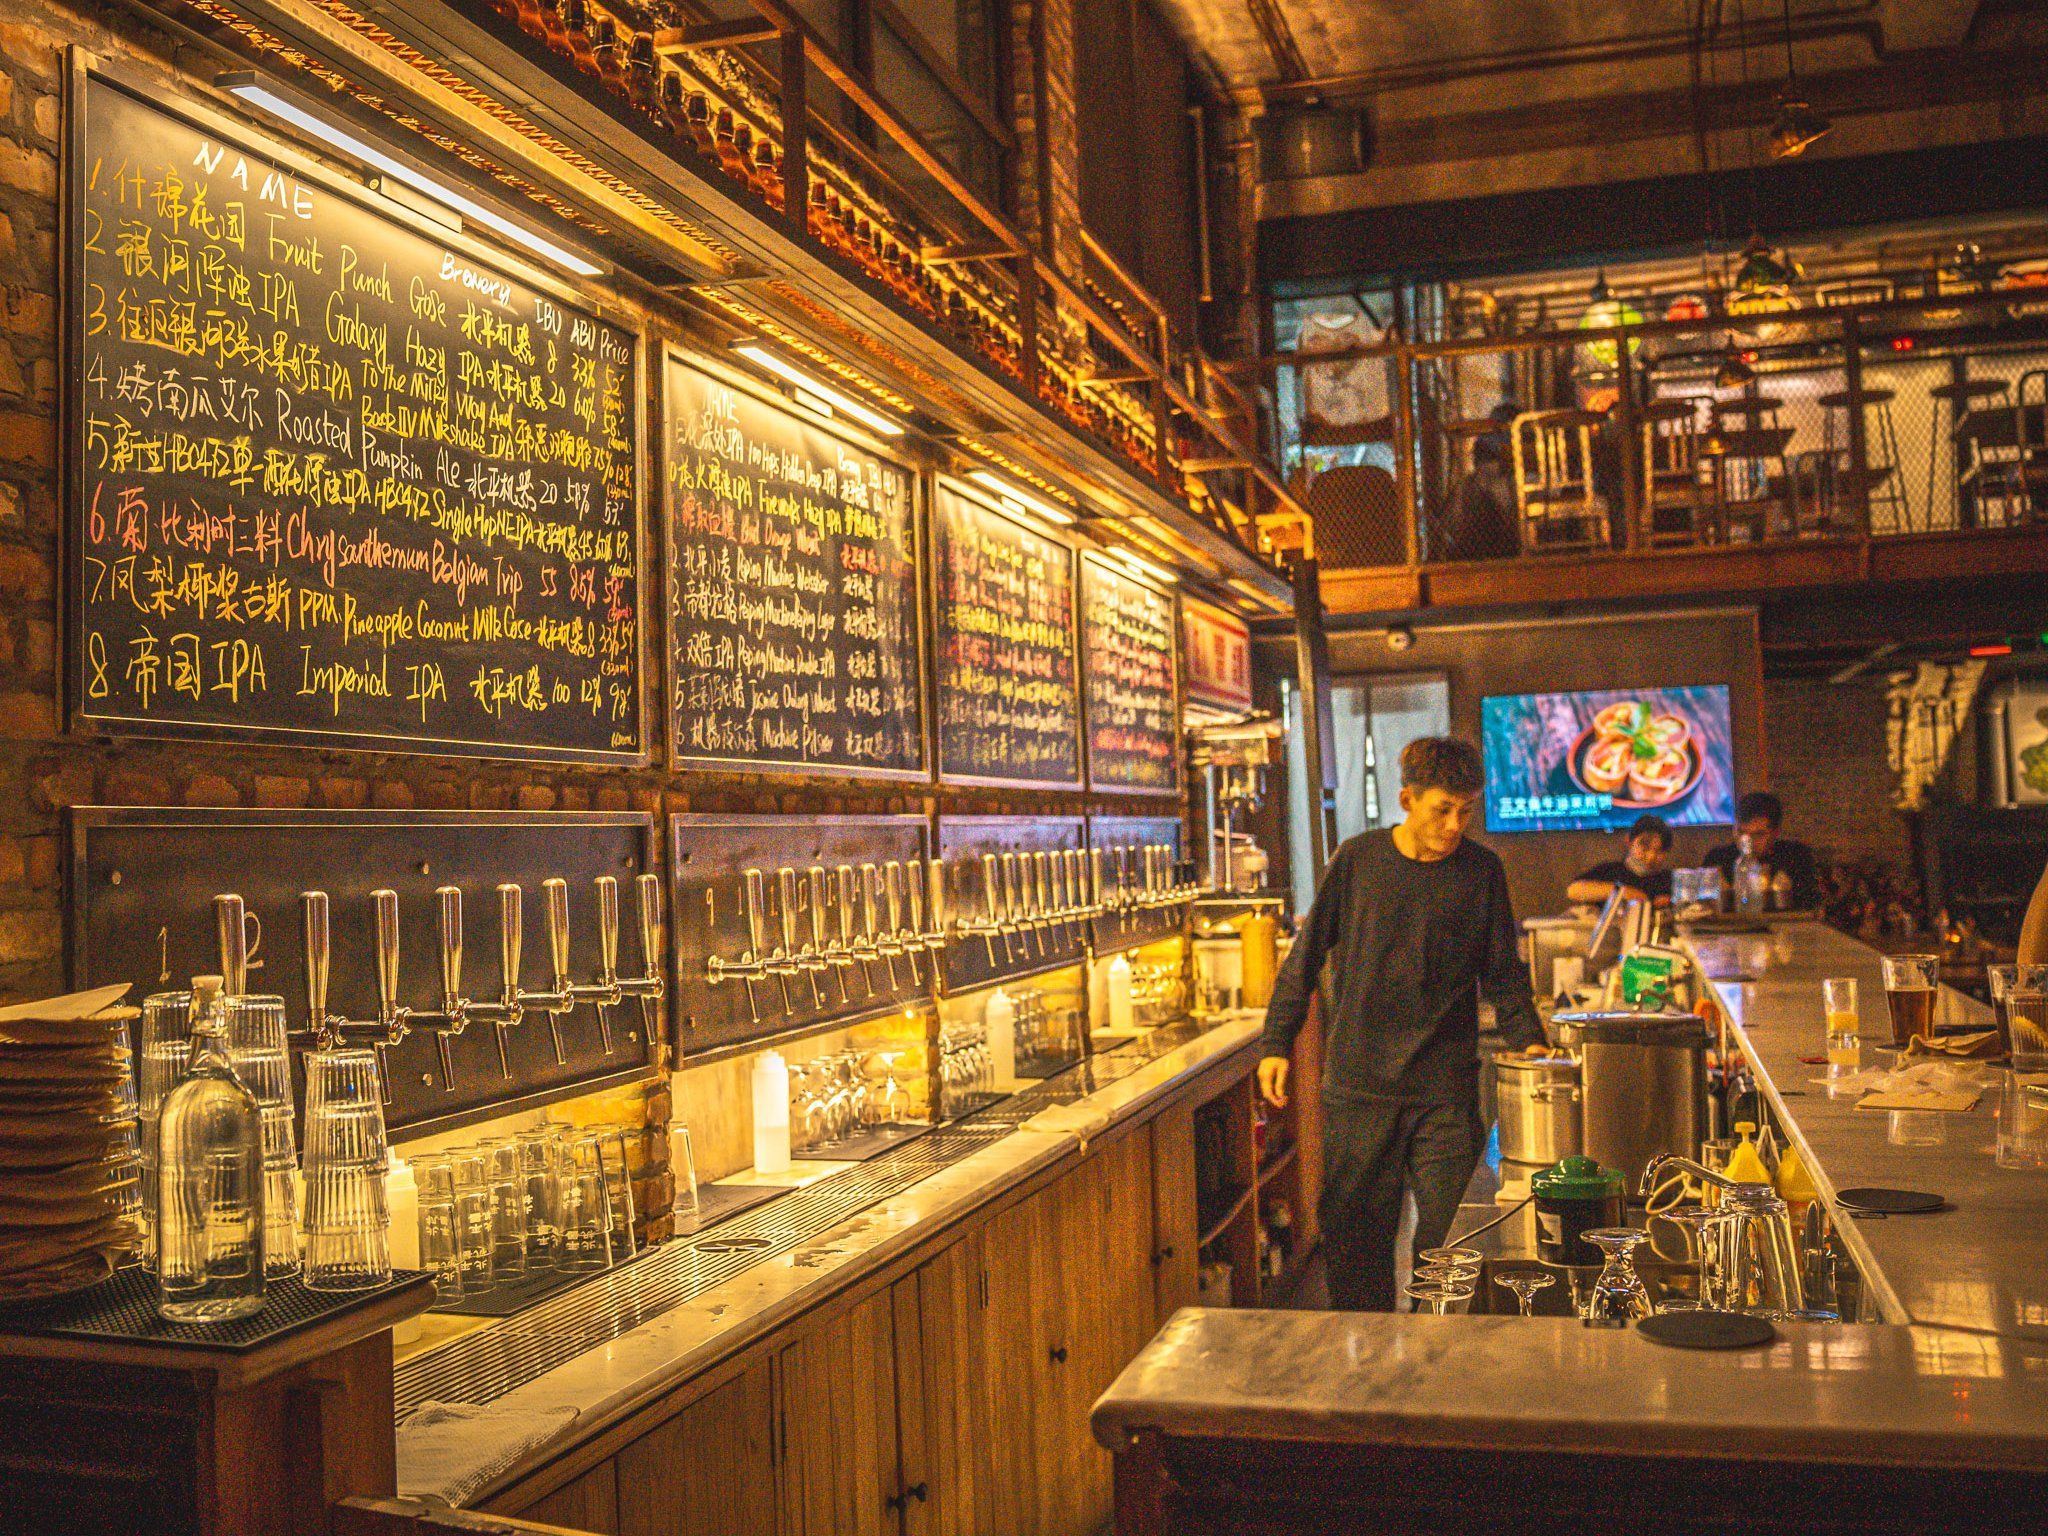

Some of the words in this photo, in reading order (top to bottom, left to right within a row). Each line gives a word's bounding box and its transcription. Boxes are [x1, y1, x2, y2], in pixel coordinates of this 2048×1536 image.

[193, 141, 314, 219] NAME
[264, 212, 324, 275] Fruit
[340, 244, 394, 304] Punch
[409, 276, 447, 327] Gose
[457, 299, 536, 367] 北平机器
[325, 290, 388, 374] Galaxy
[404, 325, 446, 388] Hazy
[456, 350, 485, 393] IPA
[549, 380, 567, 409] 20
[533, 297, 562, 335] IBU
[600, 328, 629, 365] Price
[360, 358, 379, 389] To
[383, 363, 407, 392] The
[456, 389, 487, 435] Way
[488, 400, 514, 433] And
[116, 360, 264, 432] 烤南瓜艾尔
[275, 387, 354, 460] Roasted
[361, 424, 423, 481] Pumpkin
[435, 446, 461, 488] Ale
[464, 467, 537, 512] 北平机器
[539, 480, 558, 505] 20
[488, 431, 515, 462] IPA
[430, 487, 473, 545] Single
[473, 502, 497, 547] Hop
[803, 496, 826, 542] Hazy
[825, 507, 843, 536] IPA
[110, 555, 292, 632] 凤梨椰浆古斯
[344, 592, 413, 649] Pineapple
[416, 599, 470, 643] Coconut
[472, 604, 503, 642] Milk
[493, 556, 524, 610] Trip
[539, 564, 559, 597] 55
[296, 645, 392, 718] Imperial
[404, 662, 447, 723] IPA
[469, 663, 549, 719] 北平机器
[551, 676, 571, 705] 100
[580, 674, 602, 717] 12%
